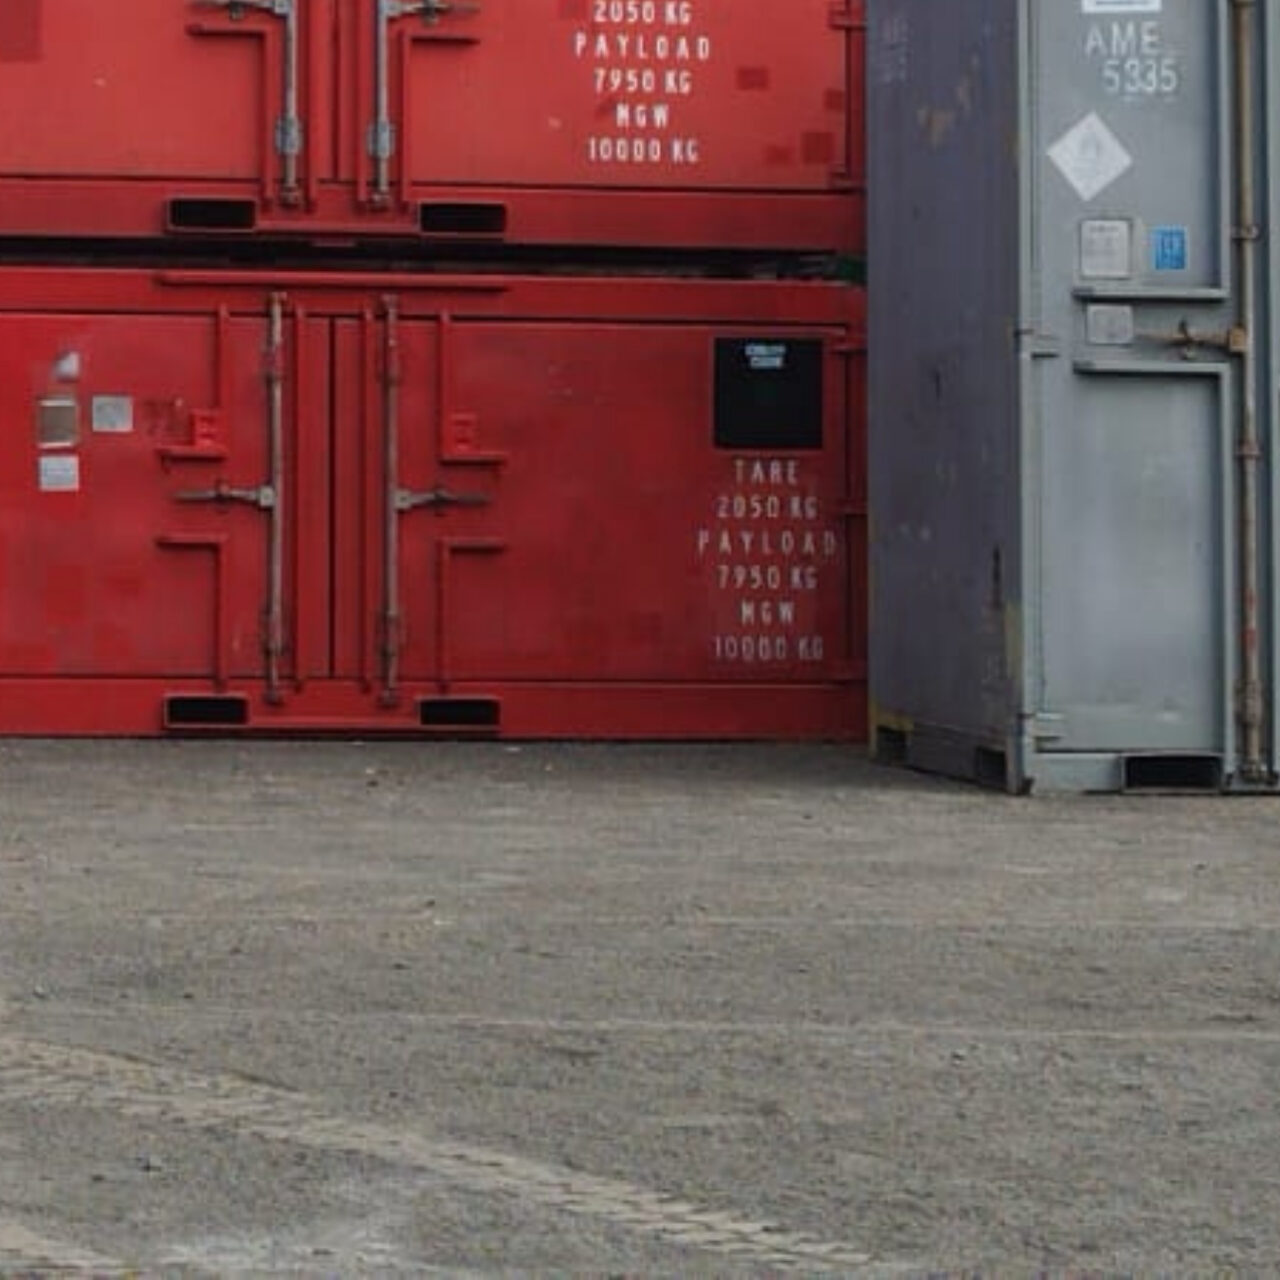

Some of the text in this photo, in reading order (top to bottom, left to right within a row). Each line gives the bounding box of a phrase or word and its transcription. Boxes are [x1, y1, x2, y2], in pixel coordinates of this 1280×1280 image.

[594, 0, 692, 25] 2050 KG
[575, 32, 710, 60] PAYLOAD
[1085, 21, 1160, 58] AME
[593, 68, 692, 94] 7950 KG
[616, 102, 669, 128] MGW
[589, 136, 699, 163] 10000 KG
[734, 459, 798, 484] TARE
[717, 495, 818, 519] 2050 KG
[698, 529, 836, 556] PAYLOAD
[718, 565, 818, 590] 7950 KG
[741, 599, 795, 625] MGW
[716, 634, 786, 661] 10000
